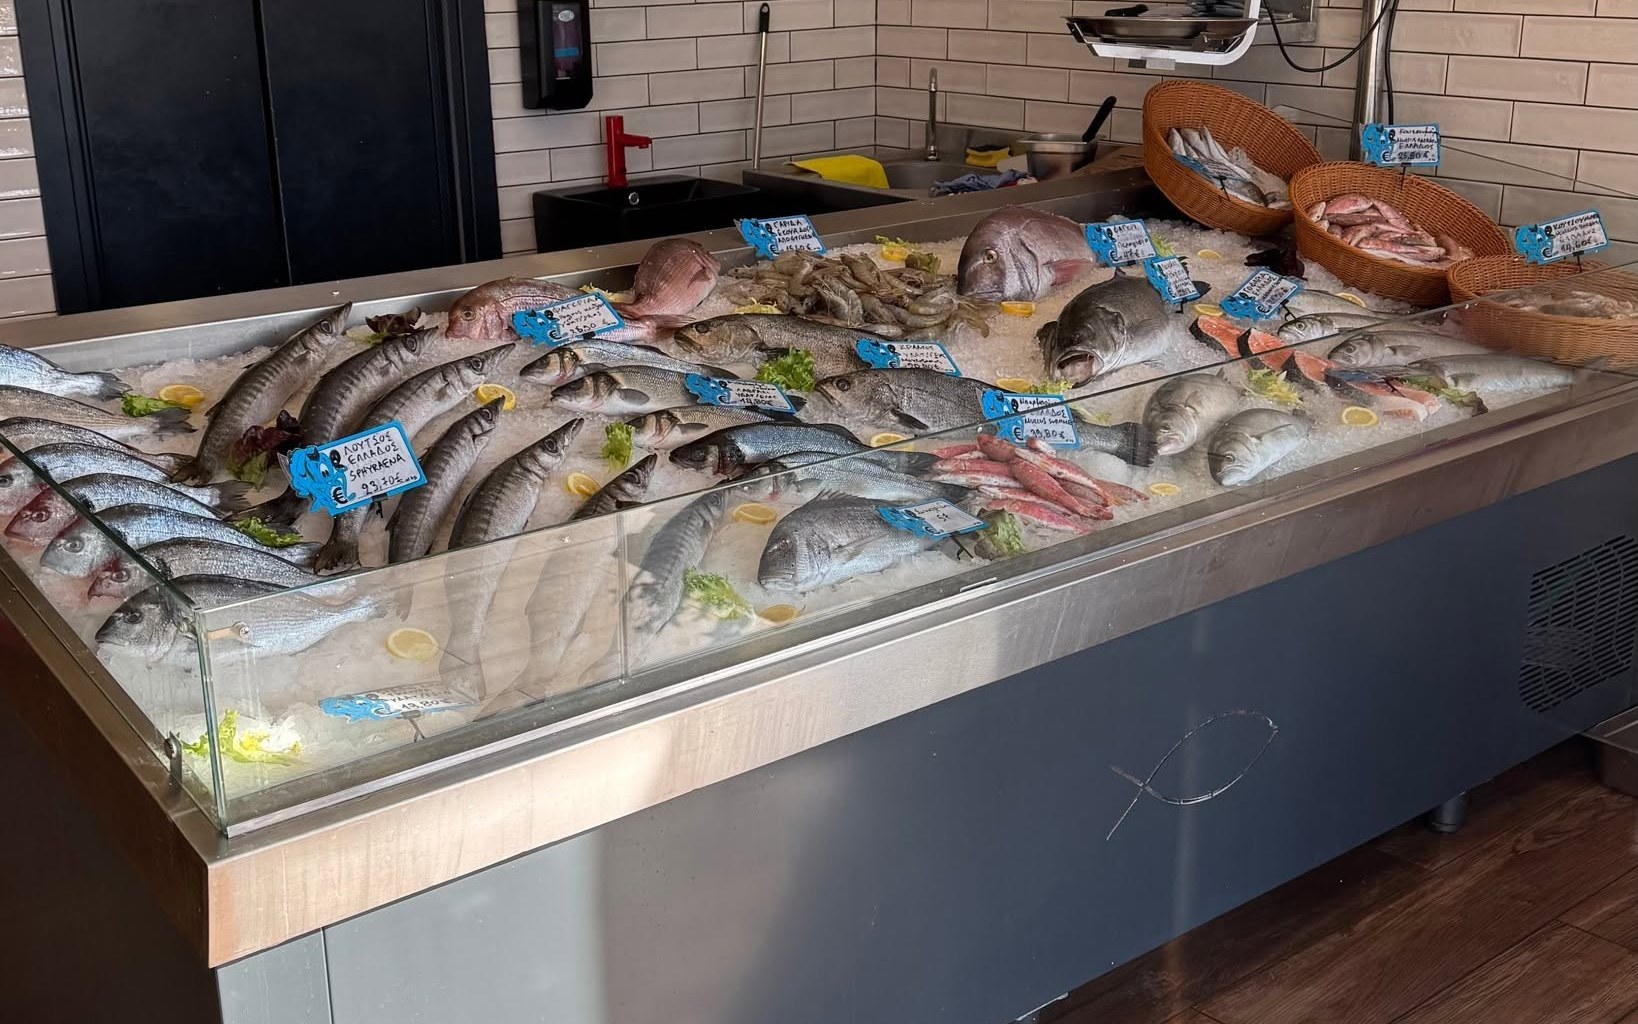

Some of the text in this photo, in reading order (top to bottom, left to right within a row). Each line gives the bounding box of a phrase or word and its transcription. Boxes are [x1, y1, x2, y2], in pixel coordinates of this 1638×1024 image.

[773, 219, 804, 230] ΓΑΡΙΔΑ
[344, 431, 393, 455] ΛΟΥΤΣΟΣ
[347, 441, 399, 465] ΕΛΛΑΔΟΣ
[349, 454, 406, 481] SPHYRAENA
